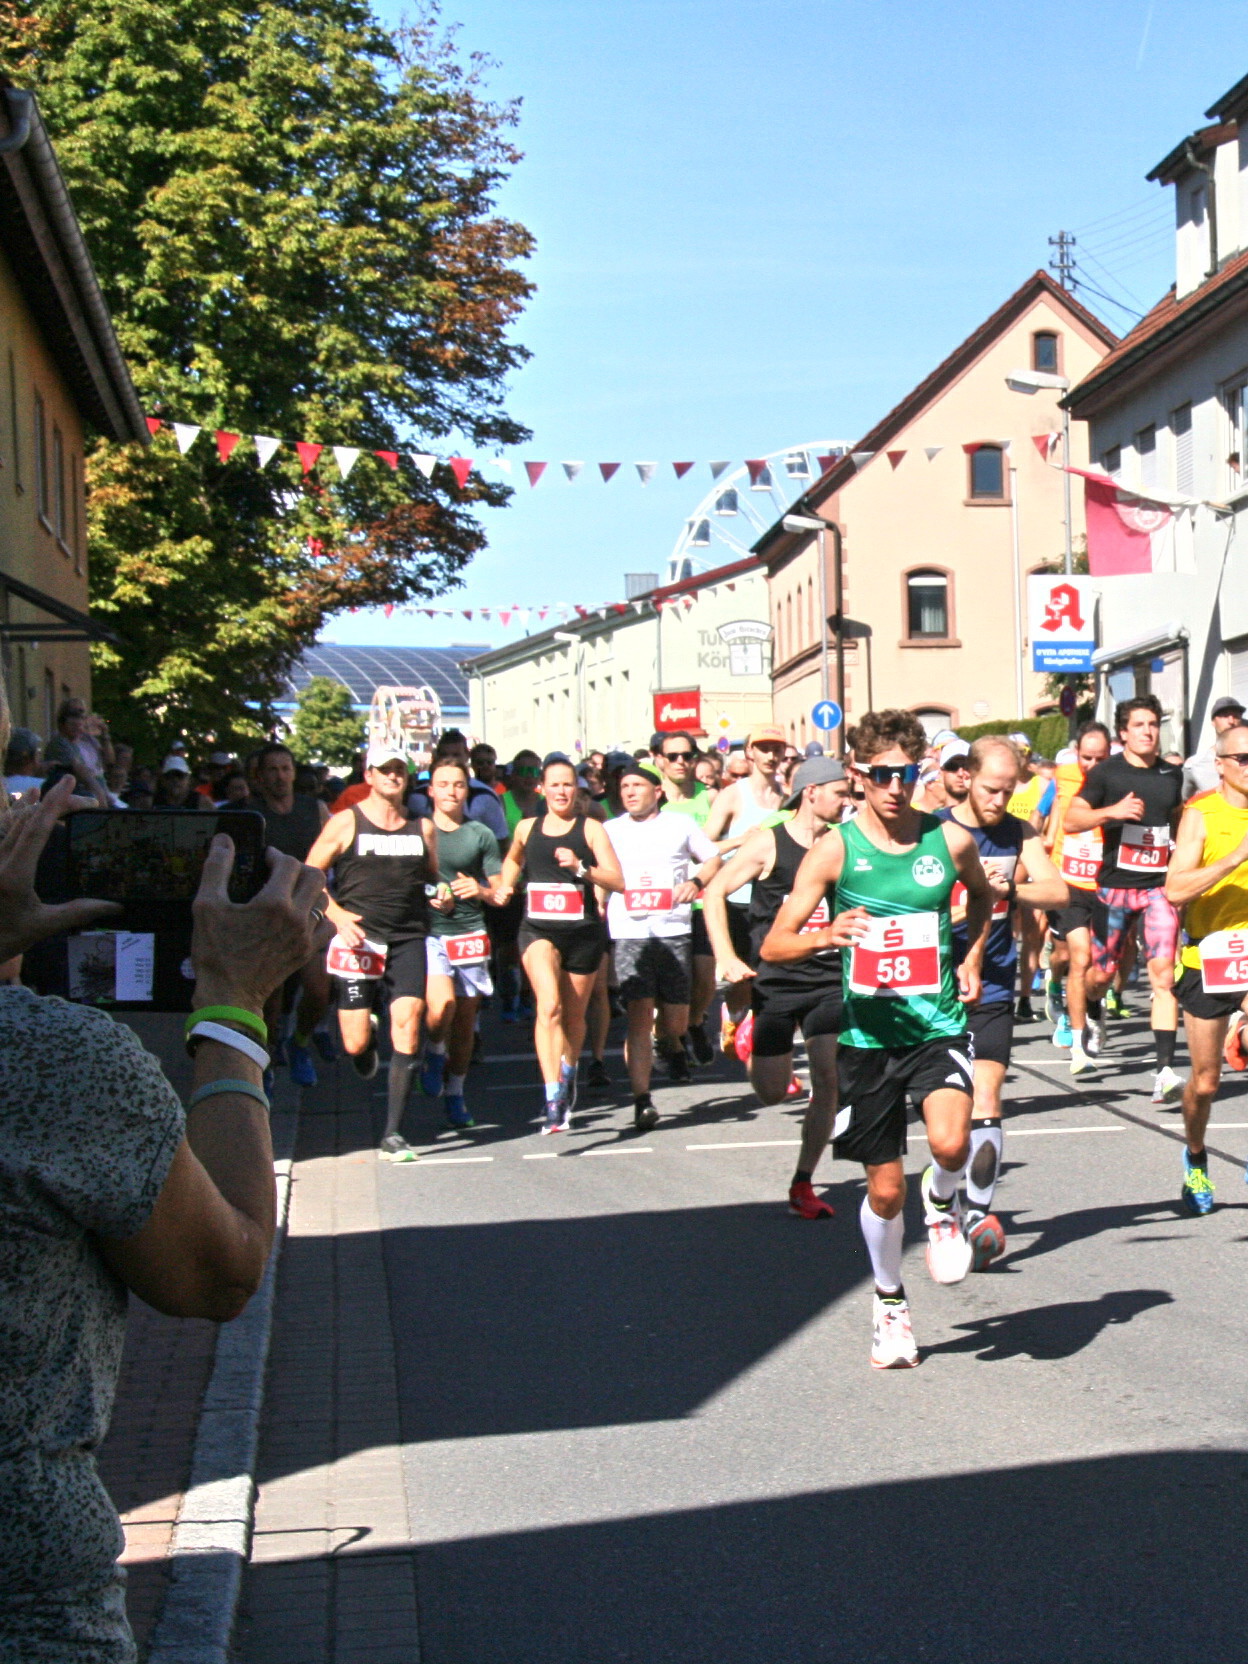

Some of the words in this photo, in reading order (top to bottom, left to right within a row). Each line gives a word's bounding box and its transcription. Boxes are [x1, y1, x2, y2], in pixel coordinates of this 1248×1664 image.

[1069, 860, 1097, 876] 519
[543, 894, 566, 911] 60
[631, 892, 662, 908] 247
[455, 938, 484, 957] 739
[877, 956, 911, 983] 58
